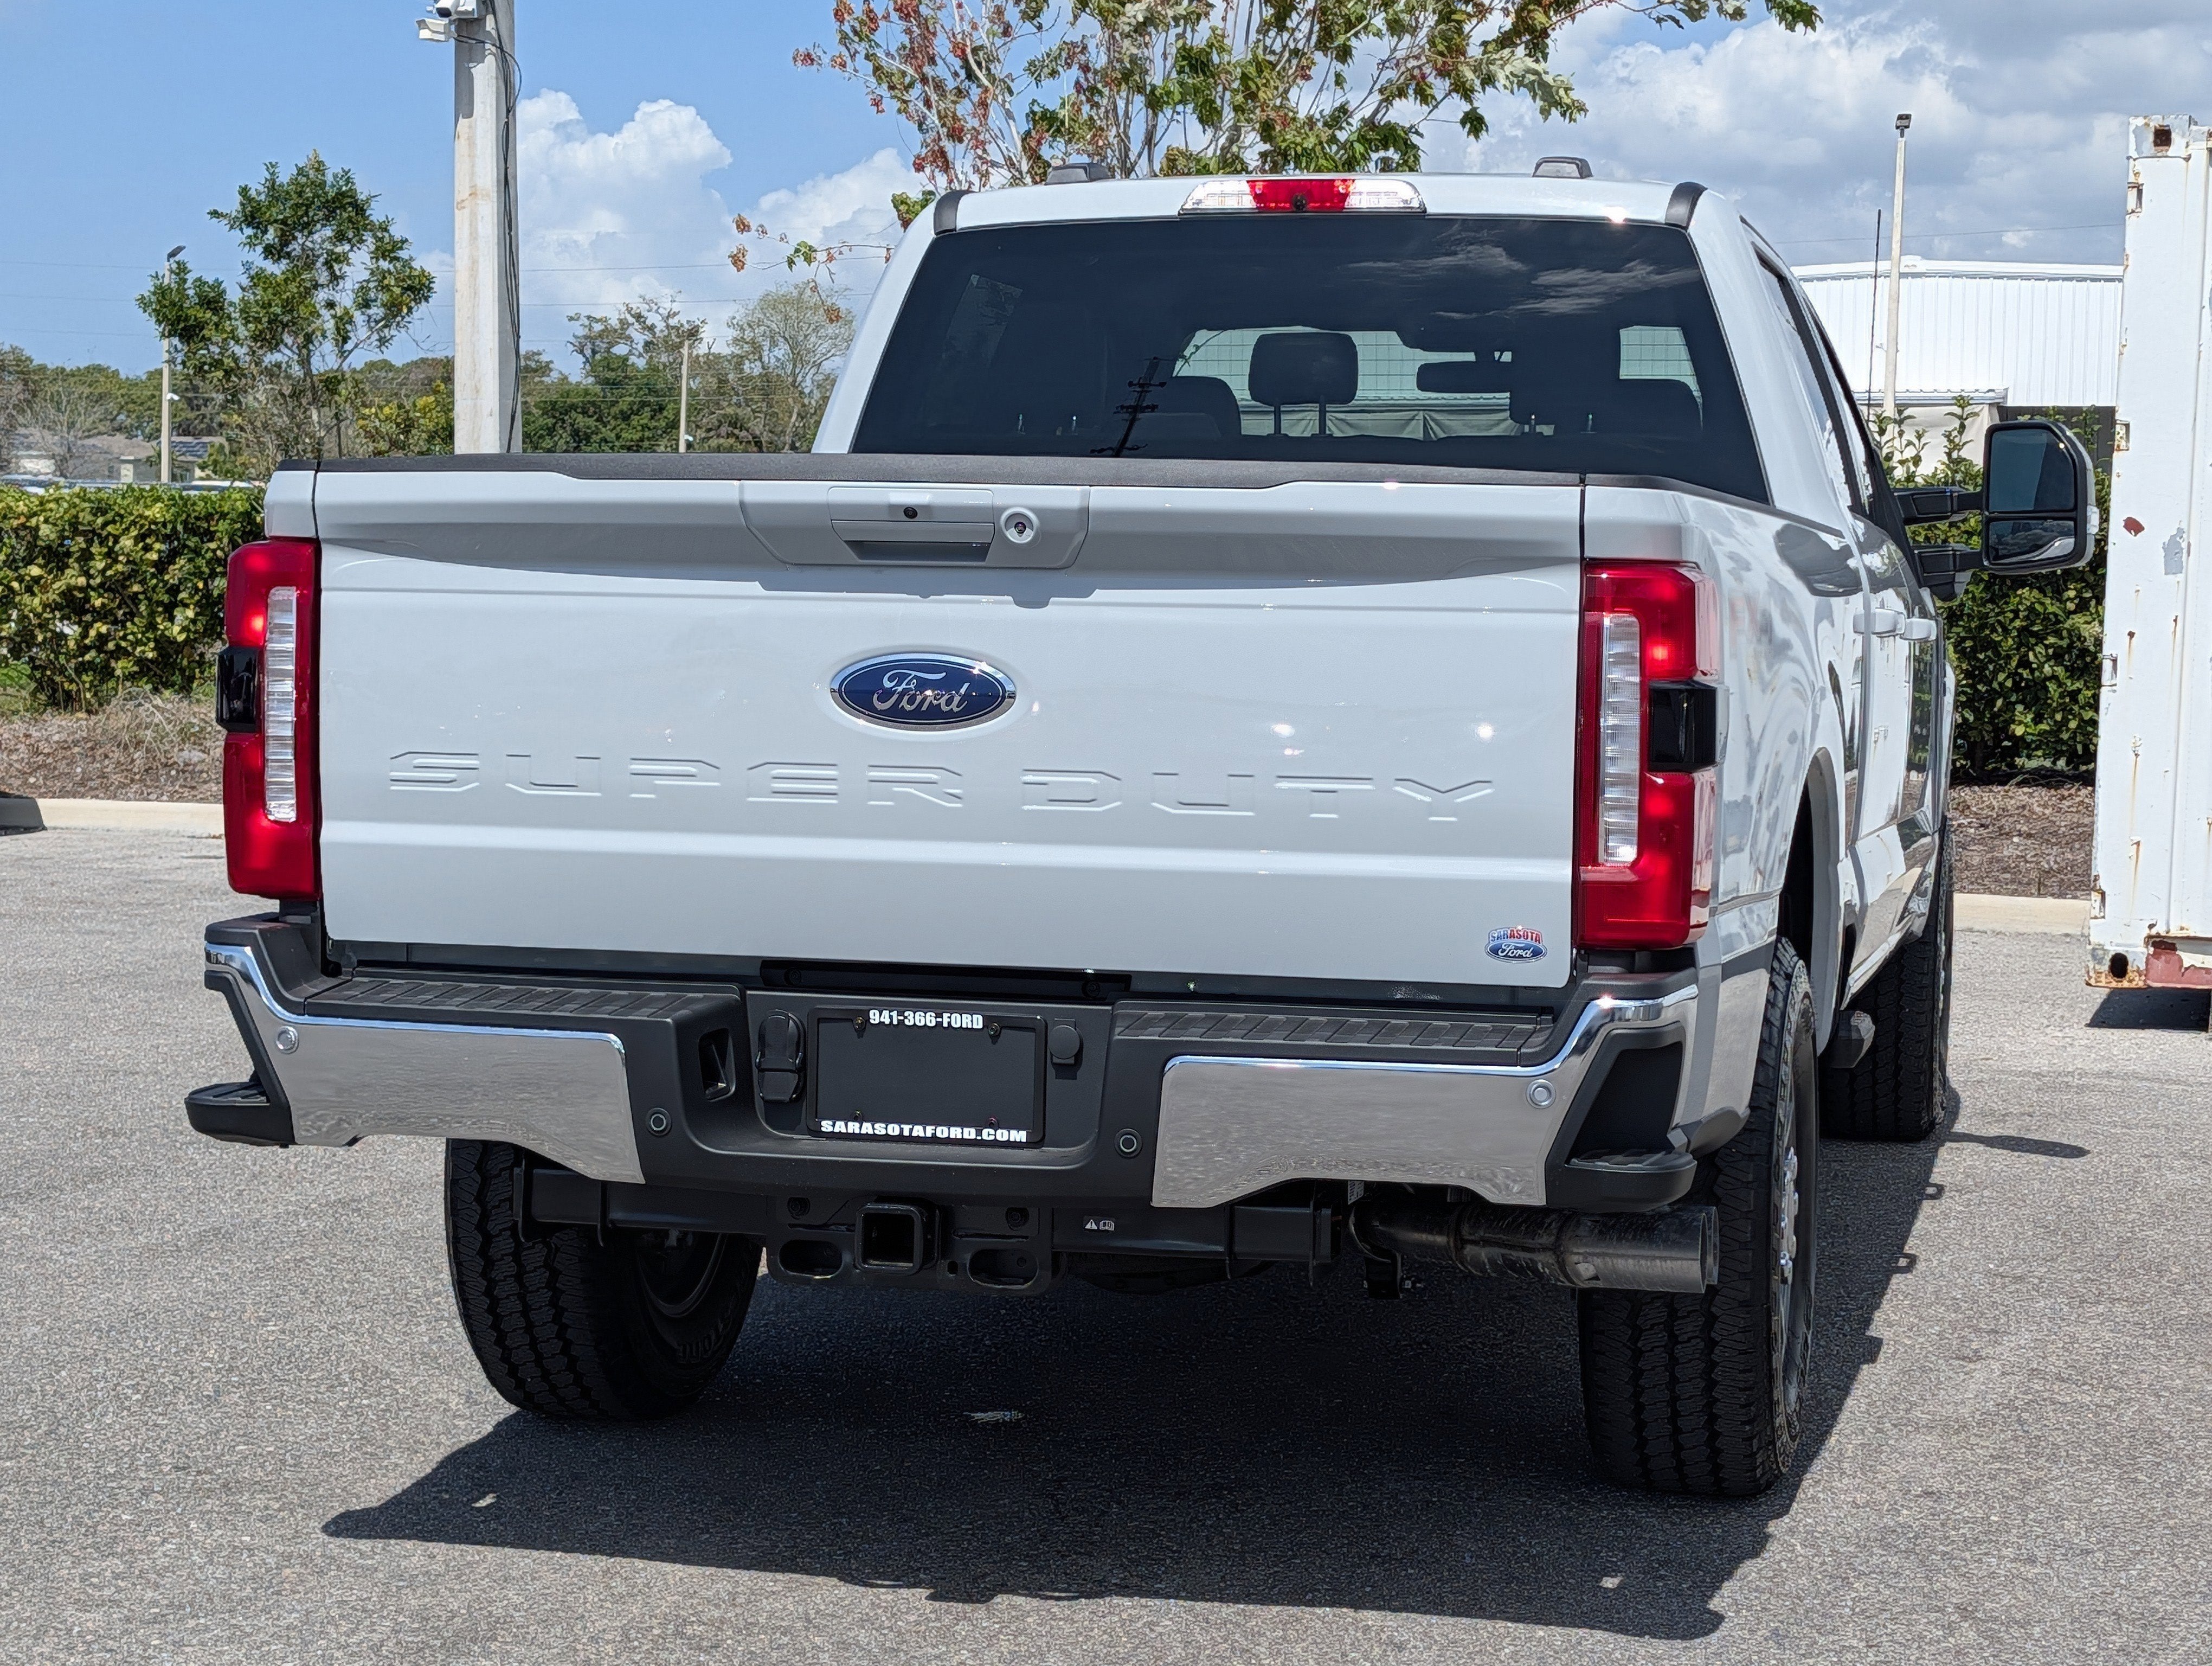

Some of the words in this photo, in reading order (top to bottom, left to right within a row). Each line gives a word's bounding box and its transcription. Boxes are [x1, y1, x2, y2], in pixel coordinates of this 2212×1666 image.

[872, 669, 970, 713] Ford
[389, 751, 963, 808] SUPER
[1021, 768, 1494, 821] DUTY
[1490, 928, 1541, 945] SARASOTA
[1497, 941, 1534, 958] Ford
[869, 1009, 984, 1029] 941-366-FORD
[820, 1120, 1028, 1143] SARASOTAFORD.COM
